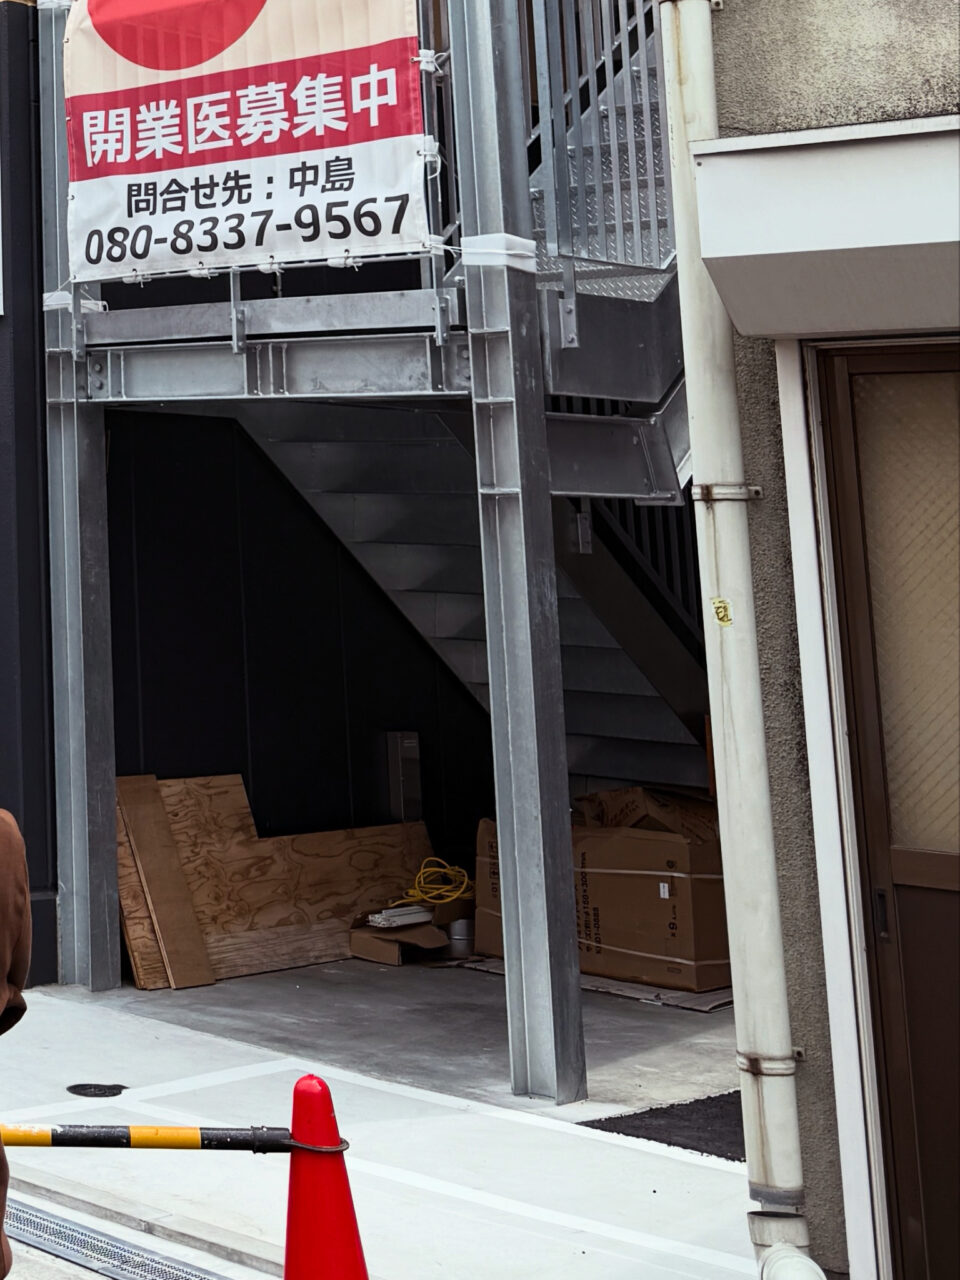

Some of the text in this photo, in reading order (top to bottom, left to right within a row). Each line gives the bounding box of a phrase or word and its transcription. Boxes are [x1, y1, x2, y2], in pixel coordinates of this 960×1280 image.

[82, 63, 398, 168] 開業医募集中
[85, 193, 410, 265] 080-8337-9567
